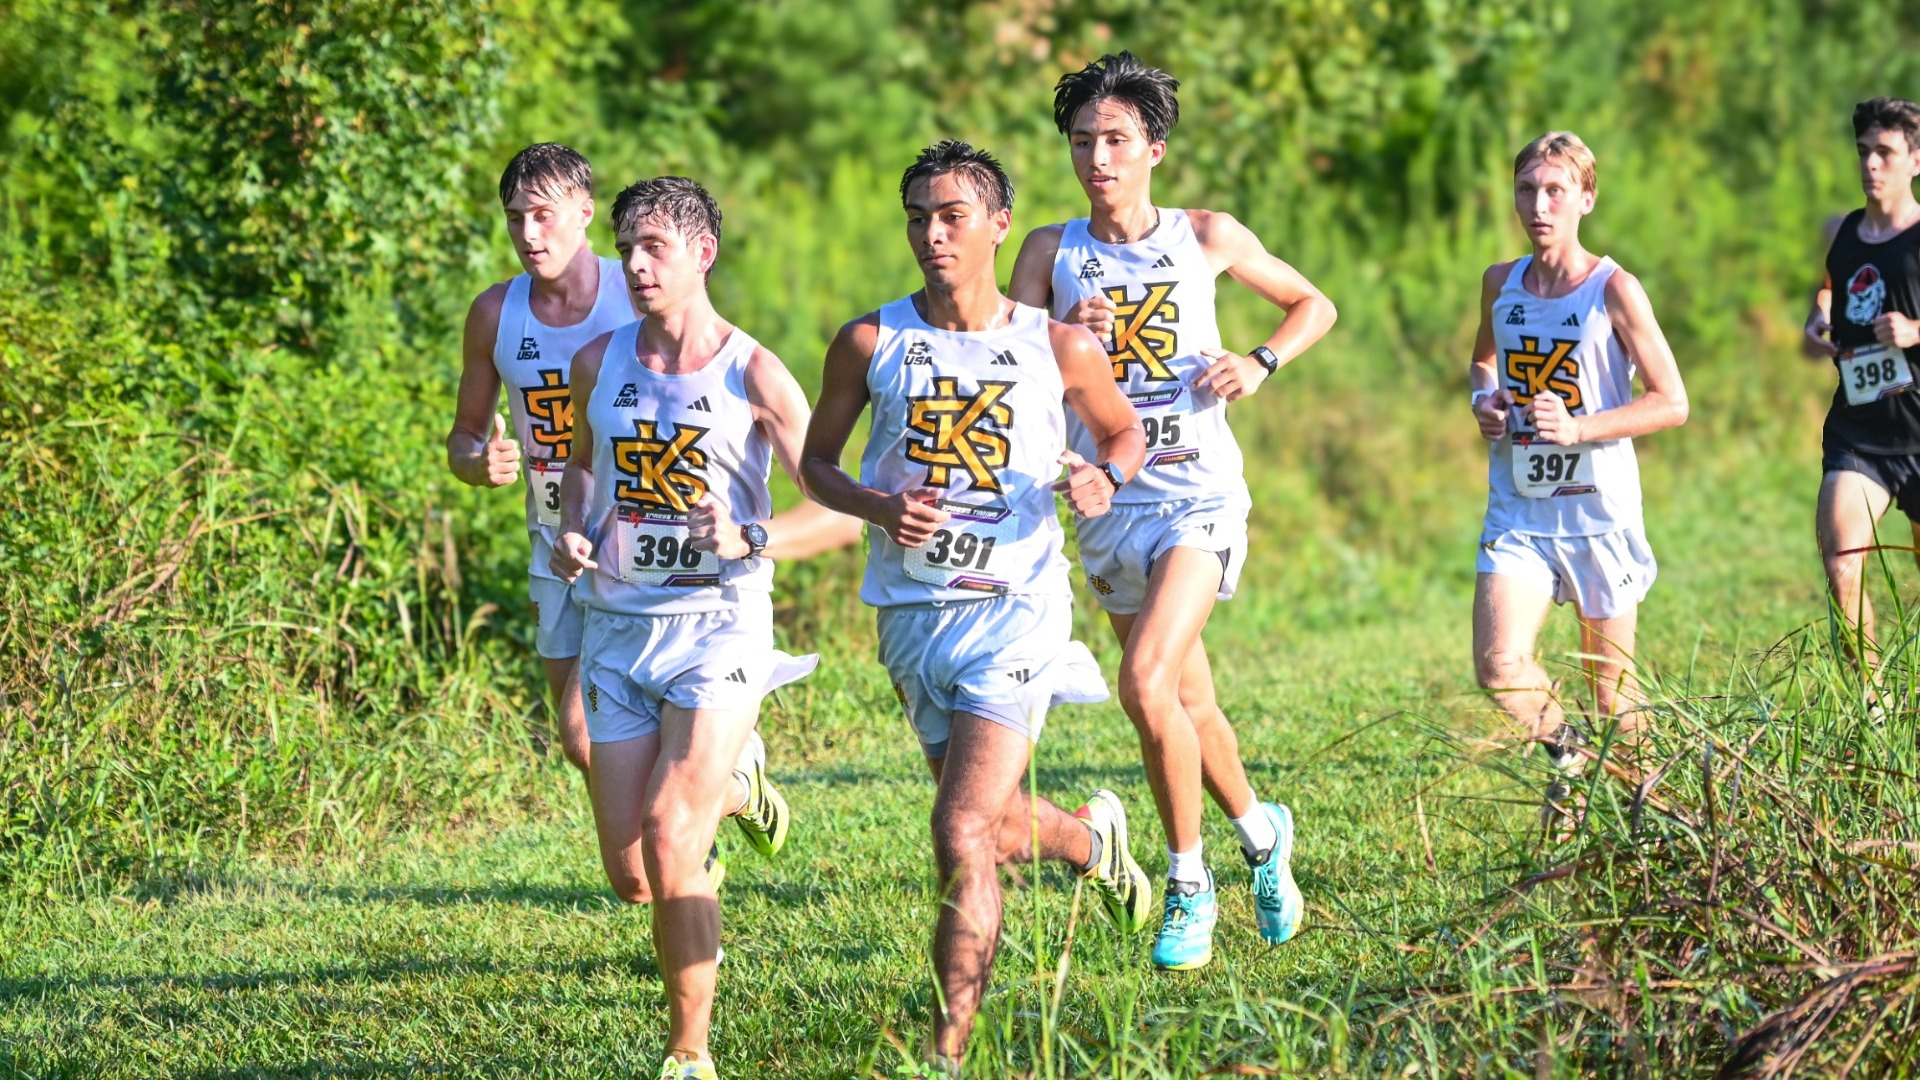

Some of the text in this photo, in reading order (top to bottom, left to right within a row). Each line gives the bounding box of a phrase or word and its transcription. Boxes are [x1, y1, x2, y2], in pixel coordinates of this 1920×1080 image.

[1079, 270, 1105, 279] USA
[1506, 316, 1526, 326] USA
[516, 351, 541, 360] USA
[904, 355, 933, 366] USA
[1853, 358, 1897, 389] 398
[612, 398, 639, 408] USA
[1142, 414, 1181, 449] 95
[1527, 453, 1581, 482] 397
[633, 534, 702, 568] 396
[926, 529, 997, 571] 391
